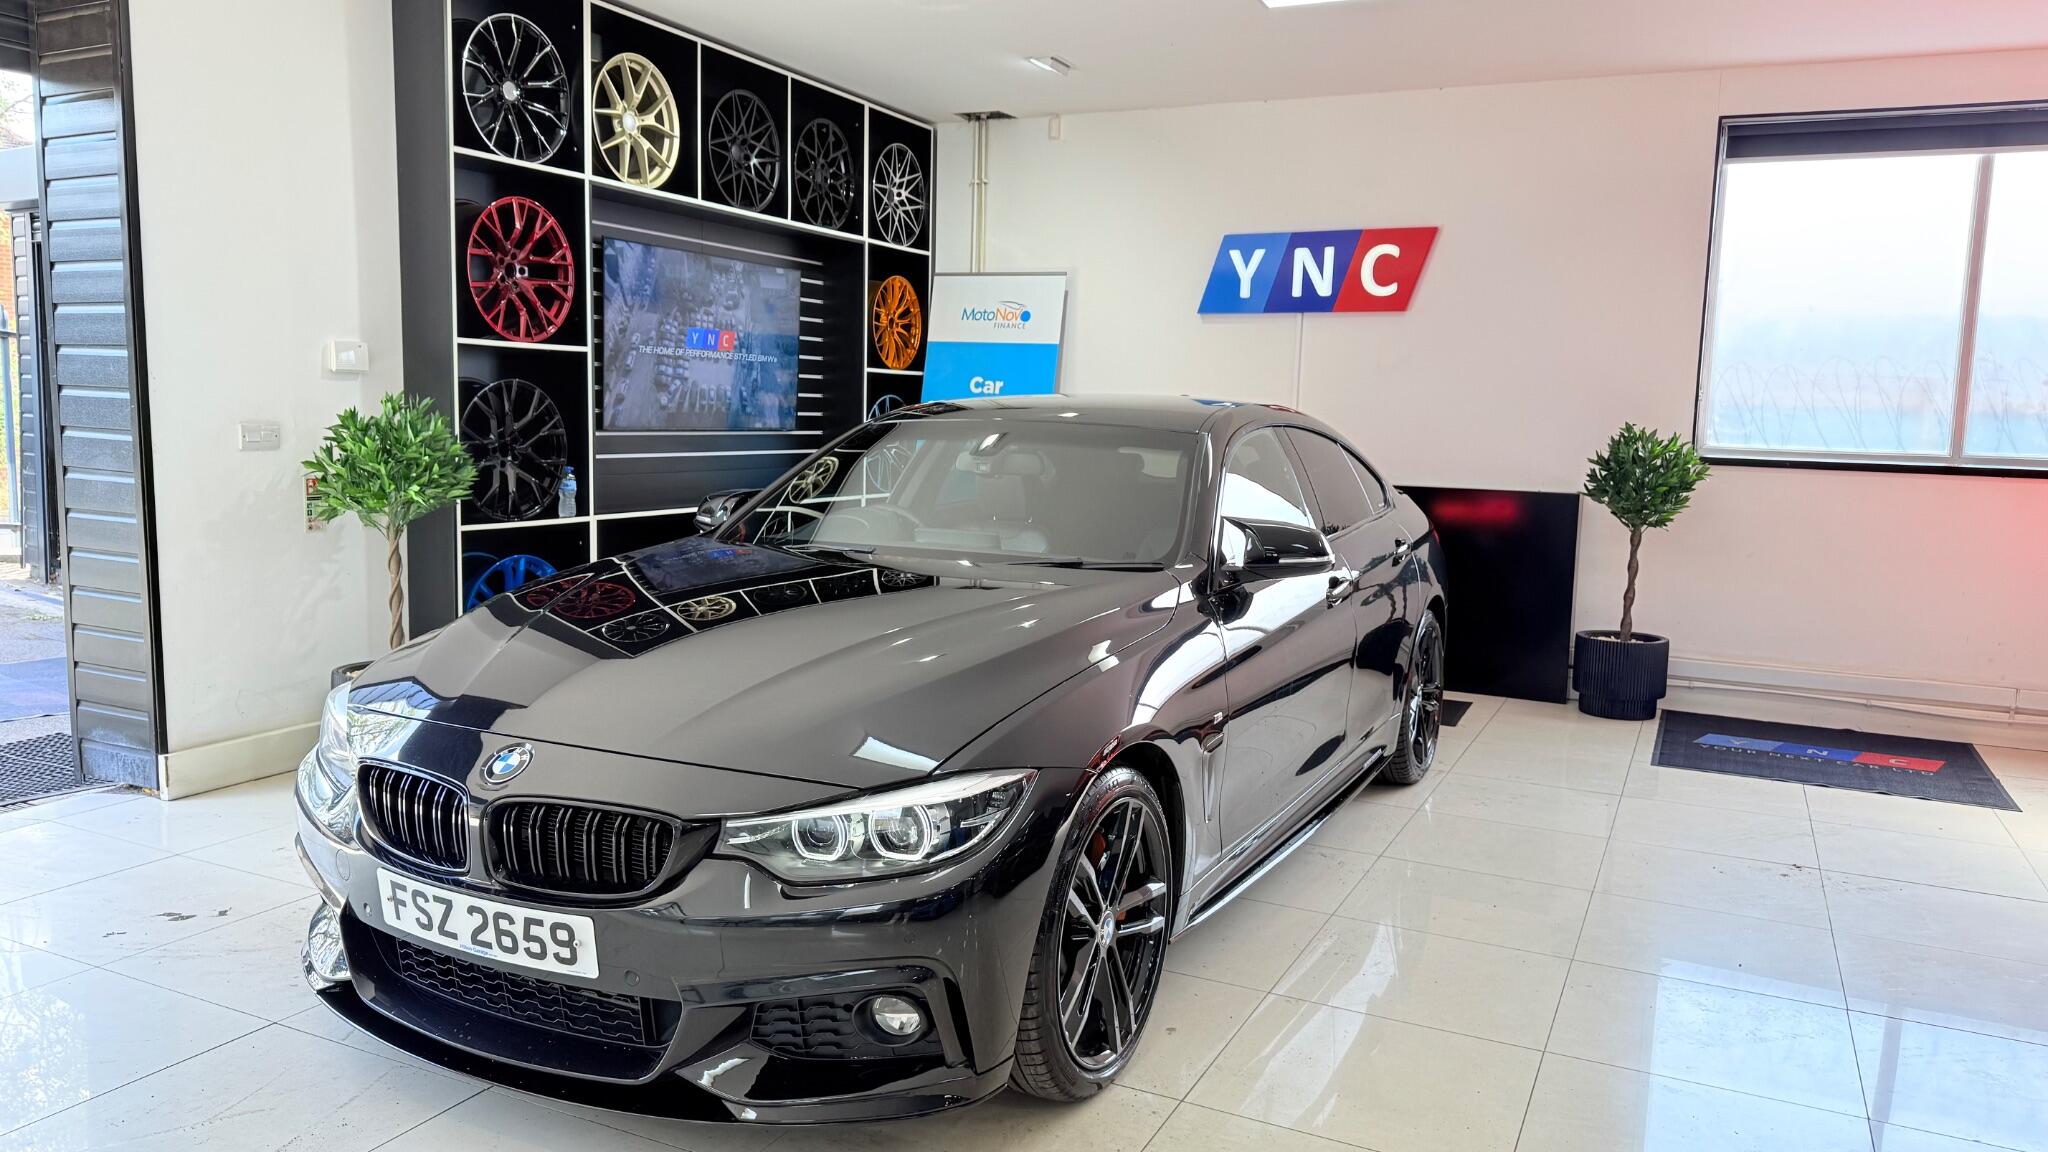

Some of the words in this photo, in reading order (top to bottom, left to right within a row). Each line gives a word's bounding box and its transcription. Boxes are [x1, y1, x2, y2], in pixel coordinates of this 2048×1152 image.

[1229, 243, 1401, 299] YNC
[993, 321, 1026, 330] FINANCE
[692, 332, 729, 348] YNC
[638, 345, 653, 354] THE
[654, 347, 676, 355] HOME
[675, 349, 685, 357] OF
[685, 350, 733, 361] PERFORMANCE
[733, 354, 757, 362] STYLED
[969, 376, 1005, 395] Car
[1699, 744, 1757, 754] YOUR
[1769, 752, 1825, 763] NEXT
[1836, 760, 1881, 769] CAR
[389, 879, 459, 941] FSZ
[466, 904, 578, 966] 2659
